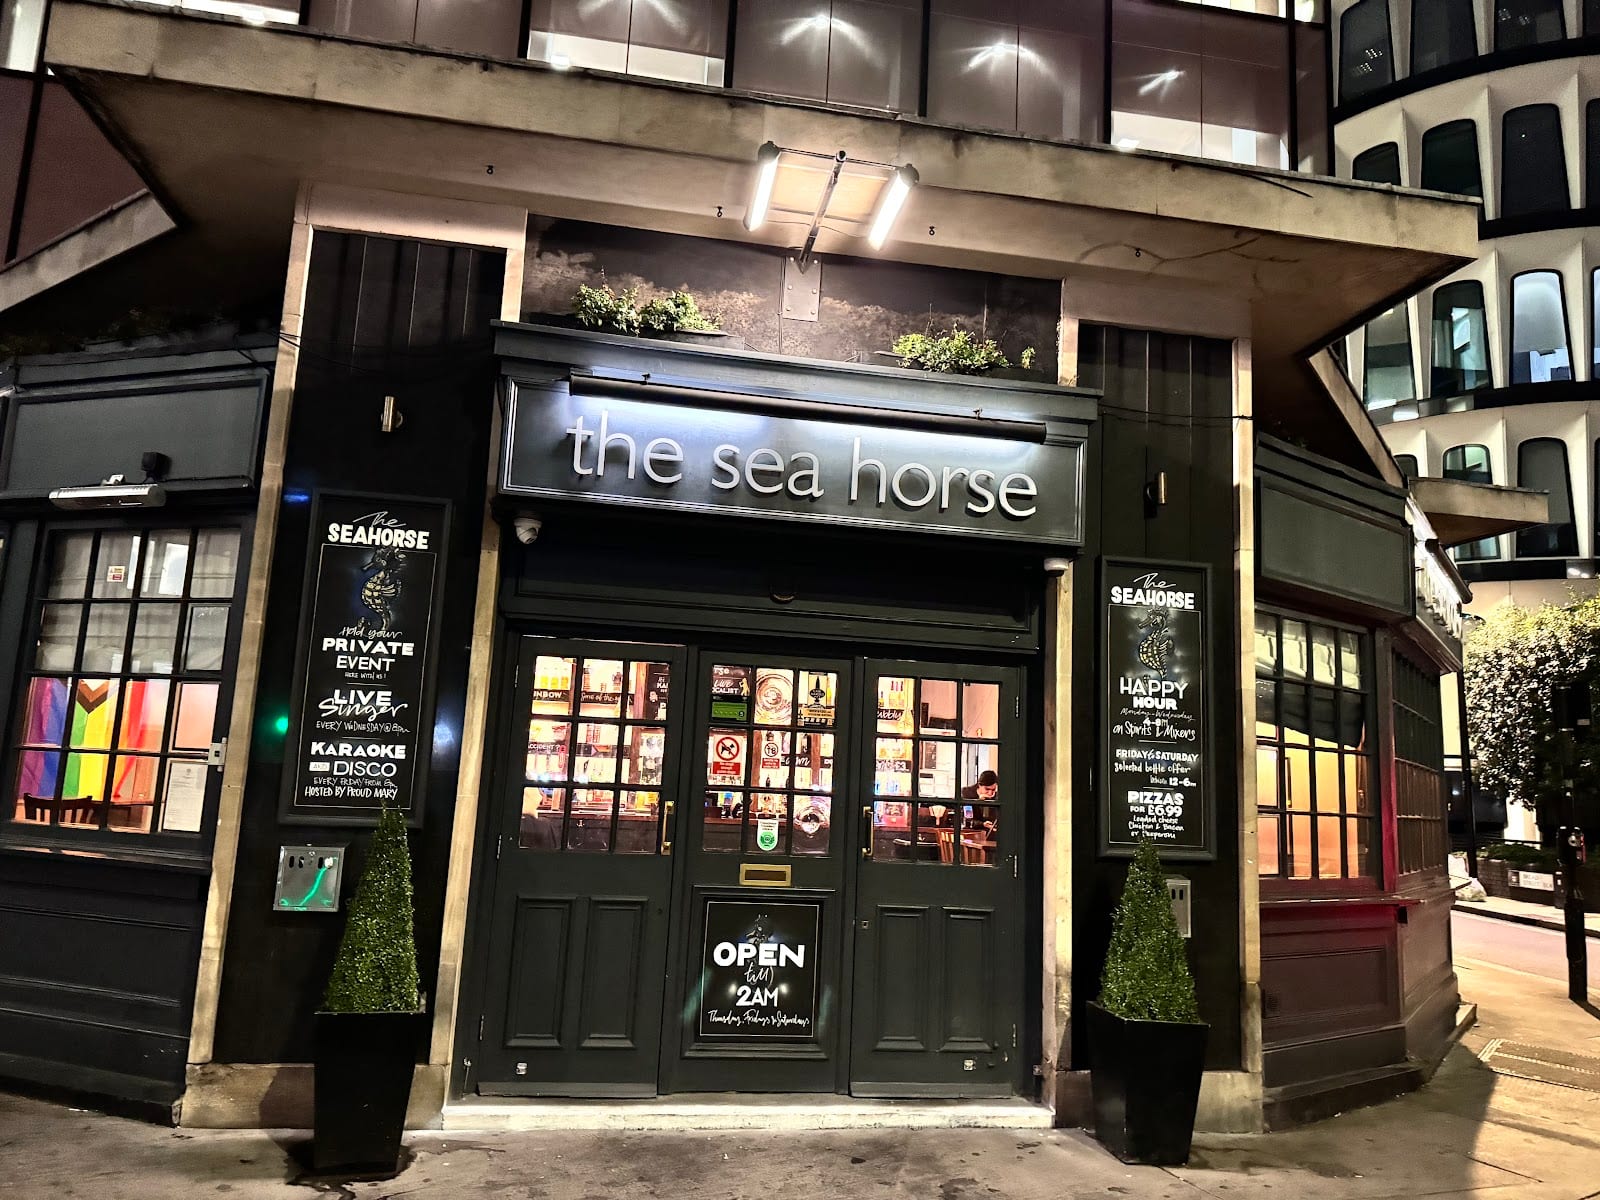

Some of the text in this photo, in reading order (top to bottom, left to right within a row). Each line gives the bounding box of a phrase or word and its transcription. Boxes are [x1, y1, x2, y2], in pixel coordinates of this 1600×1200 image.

[566, 410, 1038, 518] the sea horse
[352, 511, 407, 528] The
[328, 523, 430, 550] SEAHORSE
[1133, 573, 1176, 589] The
[1111, 586, 1195, 610] SEAHORSE
[339, 626, 402, 639] Hold your
[322, 638, 414, 656] PRIVATE
[336, 655, 396, 671] EVENT
[1120, 677, 1188, 699] HAPPY
[334, 689, 392, 706] LIVE
[1133, 696, 1177, 710] HOUR
[318, 698, 408, 722] Singer
[316, 721, 342, 731] EVERY
[1113, 725, 1123, 735] on
[1125, 721, 1152, 737] Spirits
[1164, 723, 1196, 741] Mixers
[310, 742, 406, 759] KARAOKE
[1116, 749, 1147, 758] FRIDAY
[1156, 751, 1198, 762] SATURDAY
[333, 761, 397, 777] DISCO
[1145, 761, 1166, 774] bottle
[1168, 763, 1191, 773] offer
[304, 786, 398, 801] HOSTED BY PROUD MARY
[1128, 791, 1184, 805] PIZZAS
[1148, 805, 1182, 817] £6.99
[713, 942, 805, 968] OPEN
[736, 985, 778, 1007] 2AM
